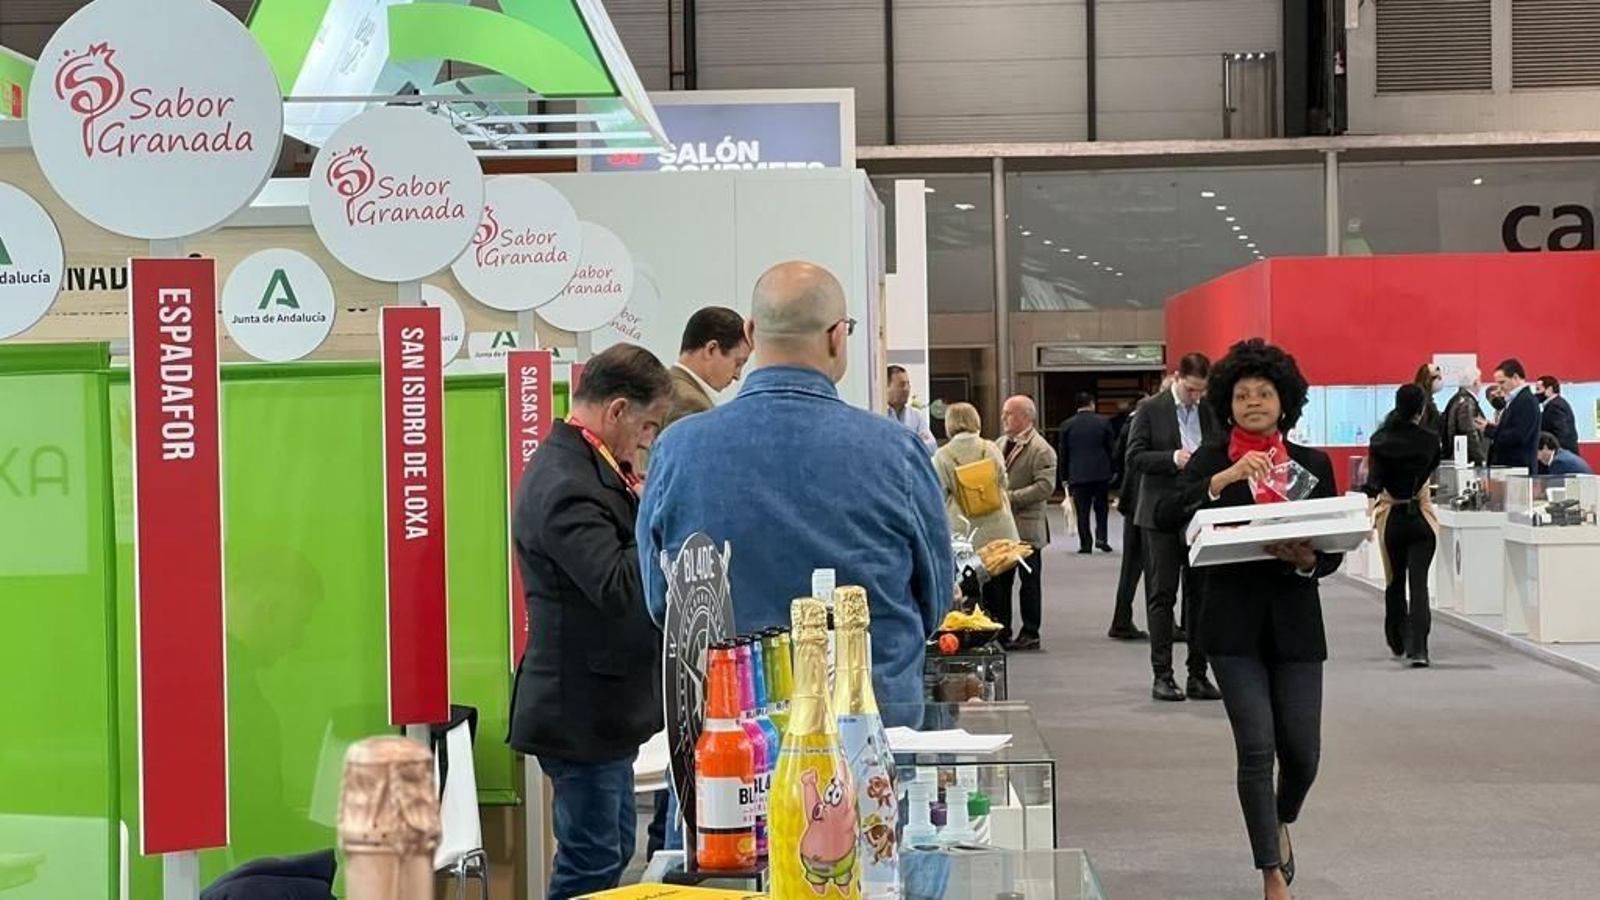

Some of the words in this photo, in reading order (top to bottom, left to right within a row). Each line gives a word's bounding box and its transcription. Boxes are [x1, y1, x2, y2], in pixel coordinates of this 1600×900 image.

[129, 86, 236, 120] Sabor
[97, 120, 254, 157] Granada
[657, 136, 760, 163] SALÓN
[378, 174, 451, 199] Sabor
[357, 197, 466, 226] Granada
[500, 228, 557, 248] Sabor
[484, 247, 569, 267] Granada
[573, 264, 613, 279] abor
[562, 280, 623, 296] ranada
[232, 314, 260, 324] Junta
[262, 313, 275, 324] de
[277, 311, 327, 323] Andalucía
[400, 327, 425, 370] SAN
[158, 288, 196, 461] ESPADAFOR
[520, 366, 539, 422] SALSAS
[402, 376, 427, 446] ISIDRO
[521, 425, 539, 436] Y
[403, 452, 428, 479] DE
[403, 485, 430, 540] LOXA
